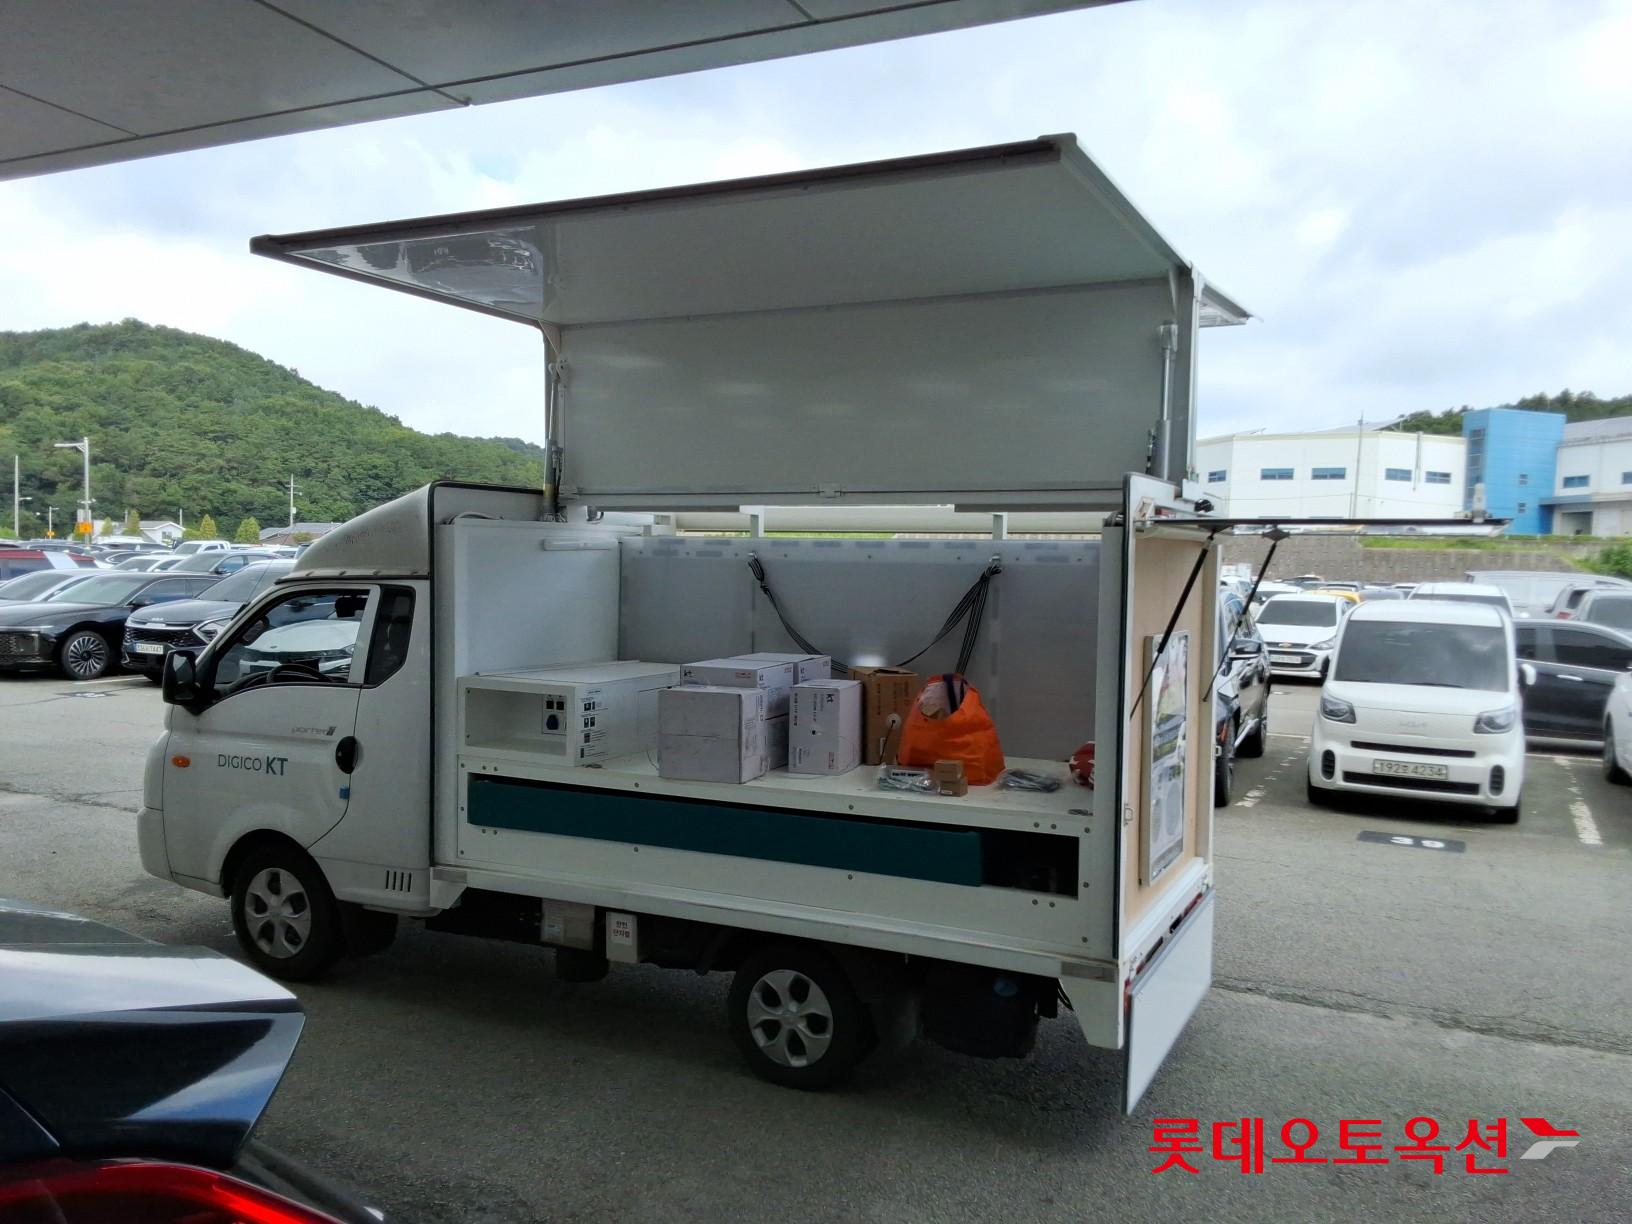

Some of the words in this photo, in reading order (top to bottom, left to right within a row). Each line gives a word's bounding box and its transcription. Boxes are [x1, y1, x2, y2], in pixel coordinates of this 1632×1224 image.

[826, 693, 835, 704] kt
[217, 754, 262, 771] DIGICO
[265, 756, 289, 776] KT
